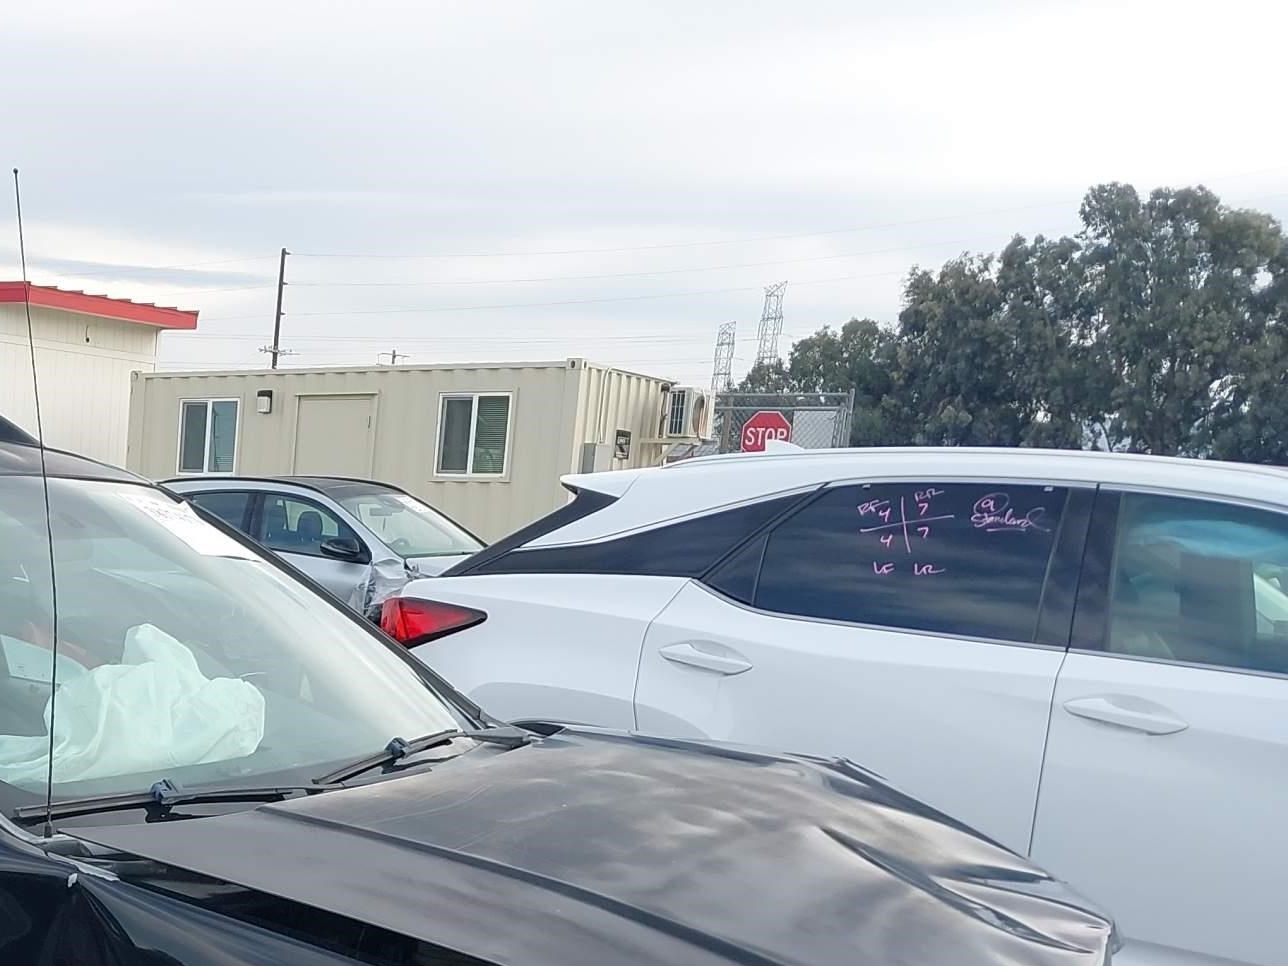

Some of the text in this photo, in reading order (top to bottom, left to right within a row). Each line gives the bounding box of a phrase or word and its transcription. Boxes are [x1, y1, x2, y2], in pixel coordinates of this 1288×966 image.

[745, 427, 787, 446] STOP
[878, 507, 891, 522] 4
[918, 502, 928, 515] 7
[917, 526, 929, 538] 7
[880, 534, 893, 547] 4
